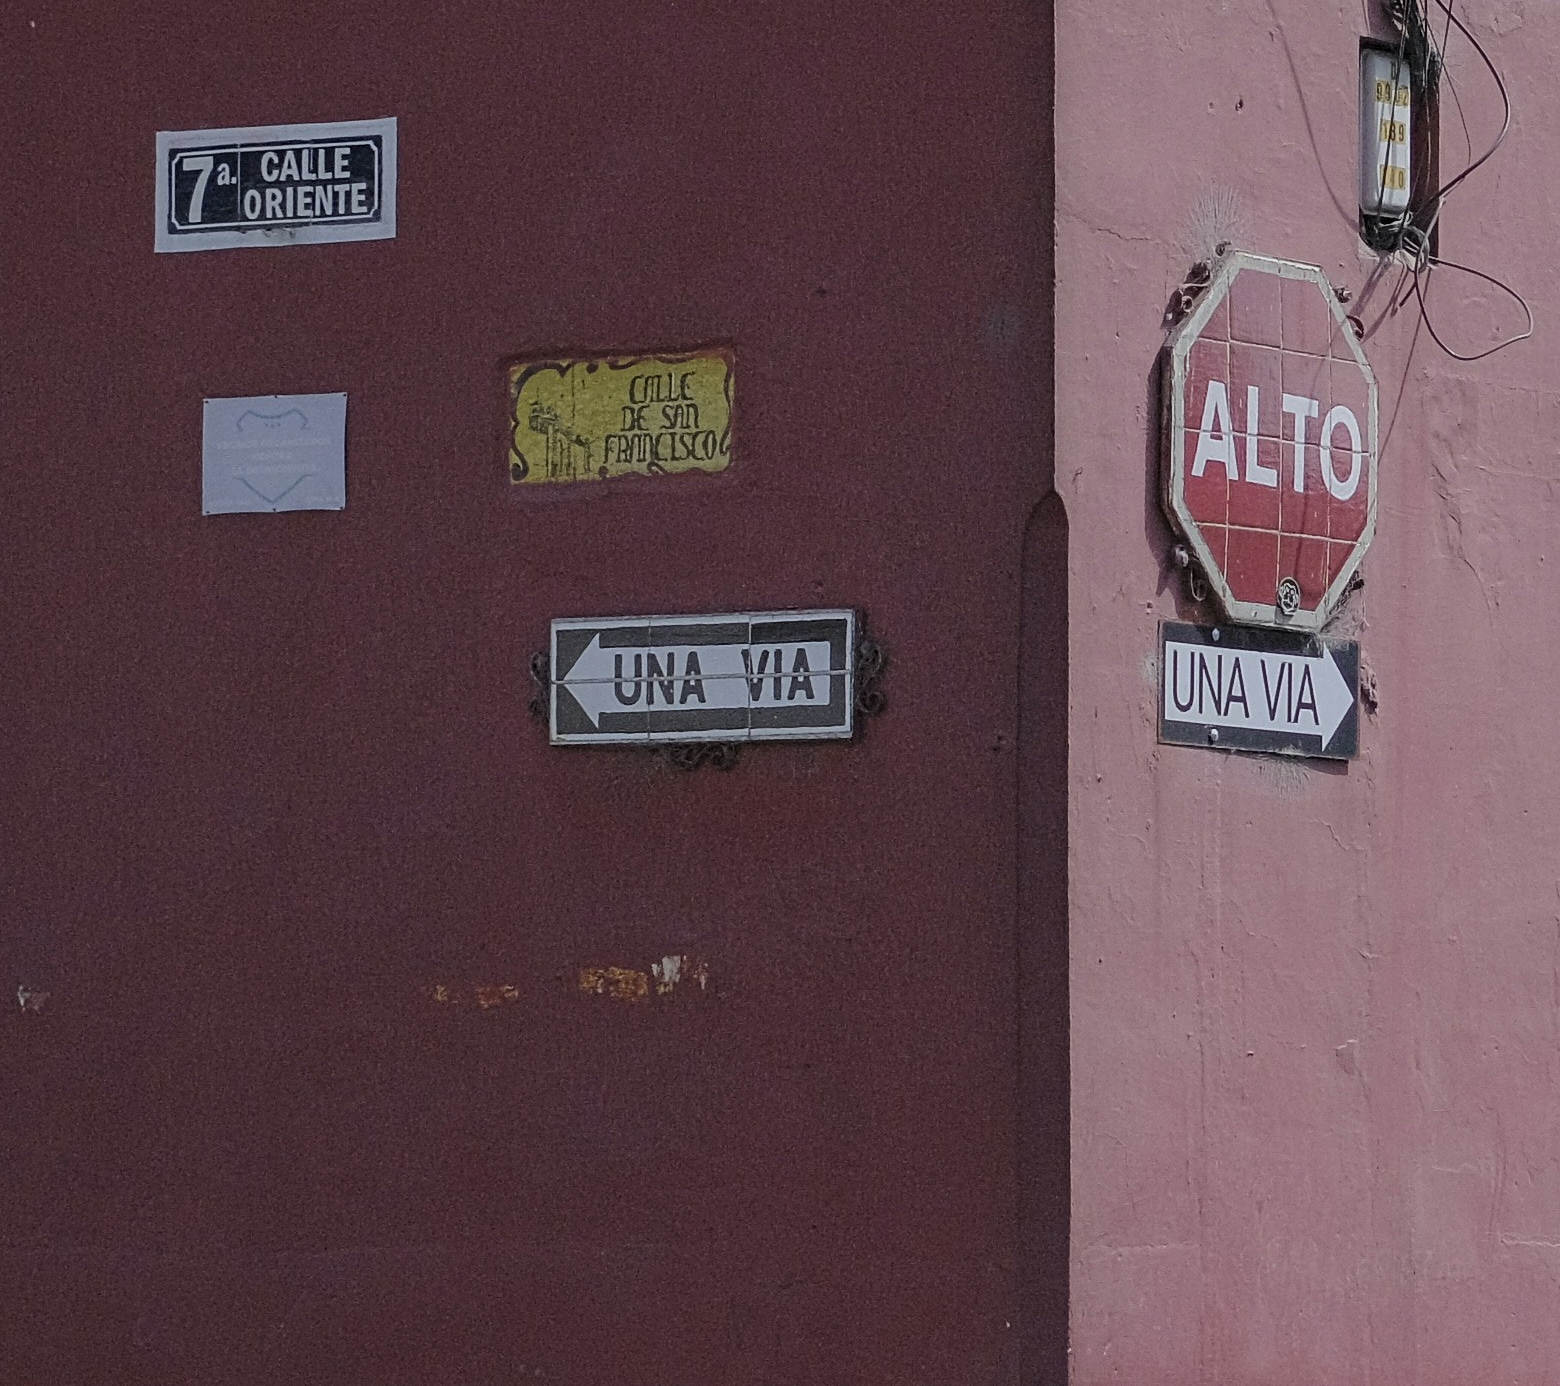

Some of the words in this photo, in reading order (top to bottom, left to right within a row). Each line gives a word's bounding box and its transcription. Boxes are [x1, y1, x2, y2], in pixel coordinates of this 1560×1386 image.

[182, 156, 237, 224] 7a.
[261, 147, 351, 182] CALLE
[243, 182, 368, 220] ORIENTE
[629, 372, 696, 404] CALLE
[621, 405, 650, 432] DE
[660, 403, 699, 430] SAN
[1191, 380, 1362, 501] ALTO
[603, 430, 718, 464] FRANCISCO
[614, 650, 707, 706] UNA
[741, 648, 815, 702] VIA
[1173, 649, 1251, 719] UNA
[1260, 659, 1320, 726] VIA
